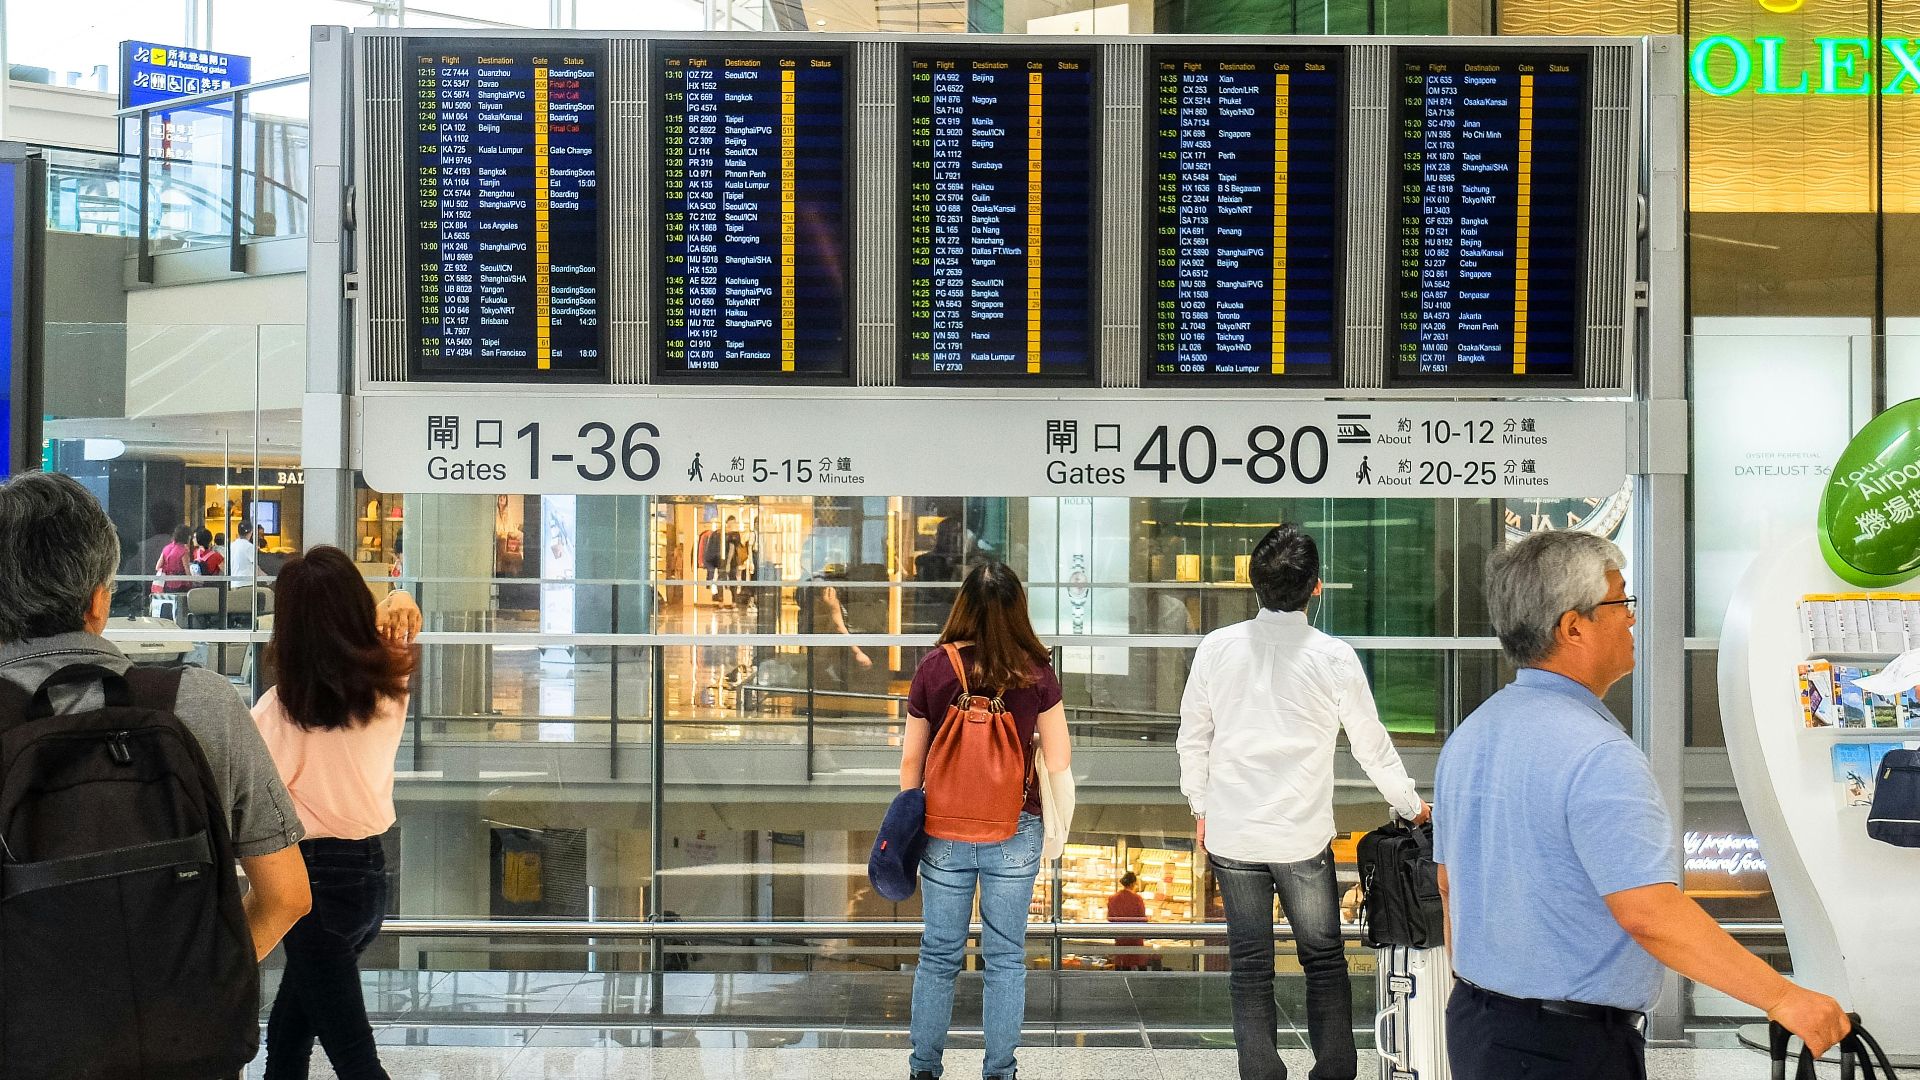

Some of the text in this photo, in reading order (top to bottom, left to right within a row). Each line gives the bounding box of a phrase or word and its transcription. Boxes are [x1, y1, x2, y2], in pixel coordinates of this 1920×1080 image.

[179, 62, 208, 74] boarding
[209, 67, 227, 75] gates
[550, 70, 594, 78] BoardingSoon
[1184, 63, 1201, 71] Flight
[1464, 77, 1496, 85] Singapore
[725, 127, 772, 135] Shanghai/PVG
[550, 169, 595, 177] BoardingSoon
[479, 190, 514, 198] Zhengzhou
[1397, 418, 1536, 432] 約 分鐘
[428, 416, 502, 450] 閘口
[1047, 420, 1121, 454] 閘口
[1376, 420, 1548, 445] About 10-12 Minutes
[428, 422, 660, 482] Gates 1-36
[1047, 425, 1329, 485] Gates 40-80
[730, 456, 851, 471] 約 分鐘
[1398, 459, 1536, 473] 約 分鐘
[709, 459, 865, 483] About 5-15 Minutes
[1377, 461, 1549, 486] About 20-25 Minutes
[1735, 466, 1831, 476] DATEJUST 36
